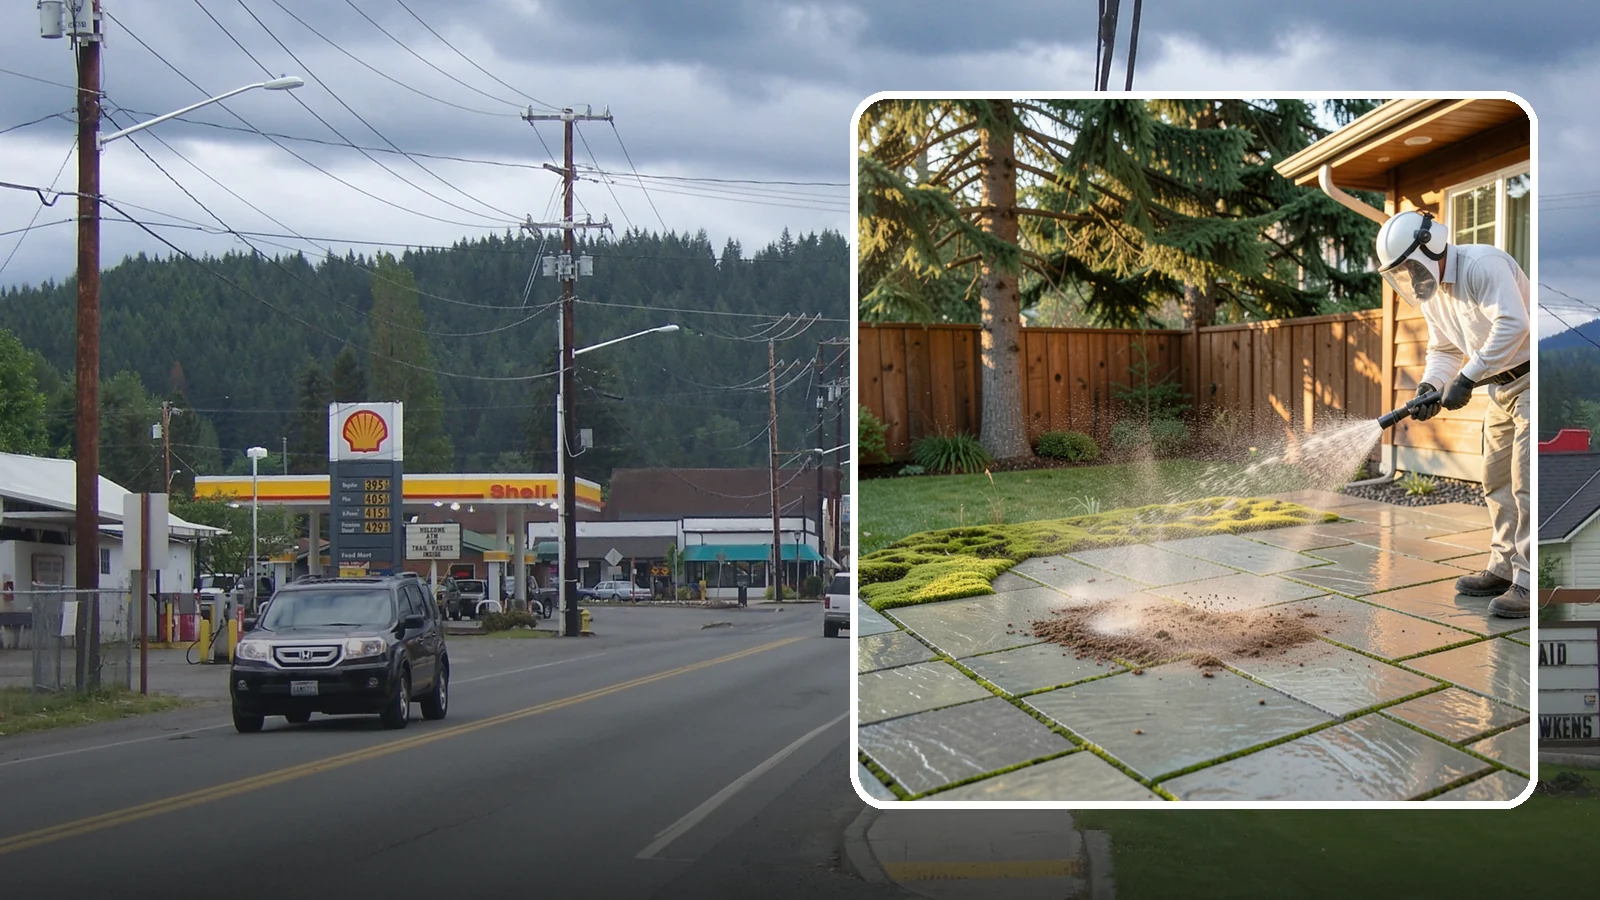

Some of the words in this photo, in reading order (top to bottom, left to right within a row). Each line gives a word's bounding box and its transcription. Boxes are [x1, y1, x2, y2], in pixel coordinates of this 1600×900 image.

[366, 480, 383, 490] 395
[490, 484, 547, 499] Shell
[366, 494, 383, 504] 405
[366, 508, 383, 518] 415
[366, 522, 383, 532] 429
